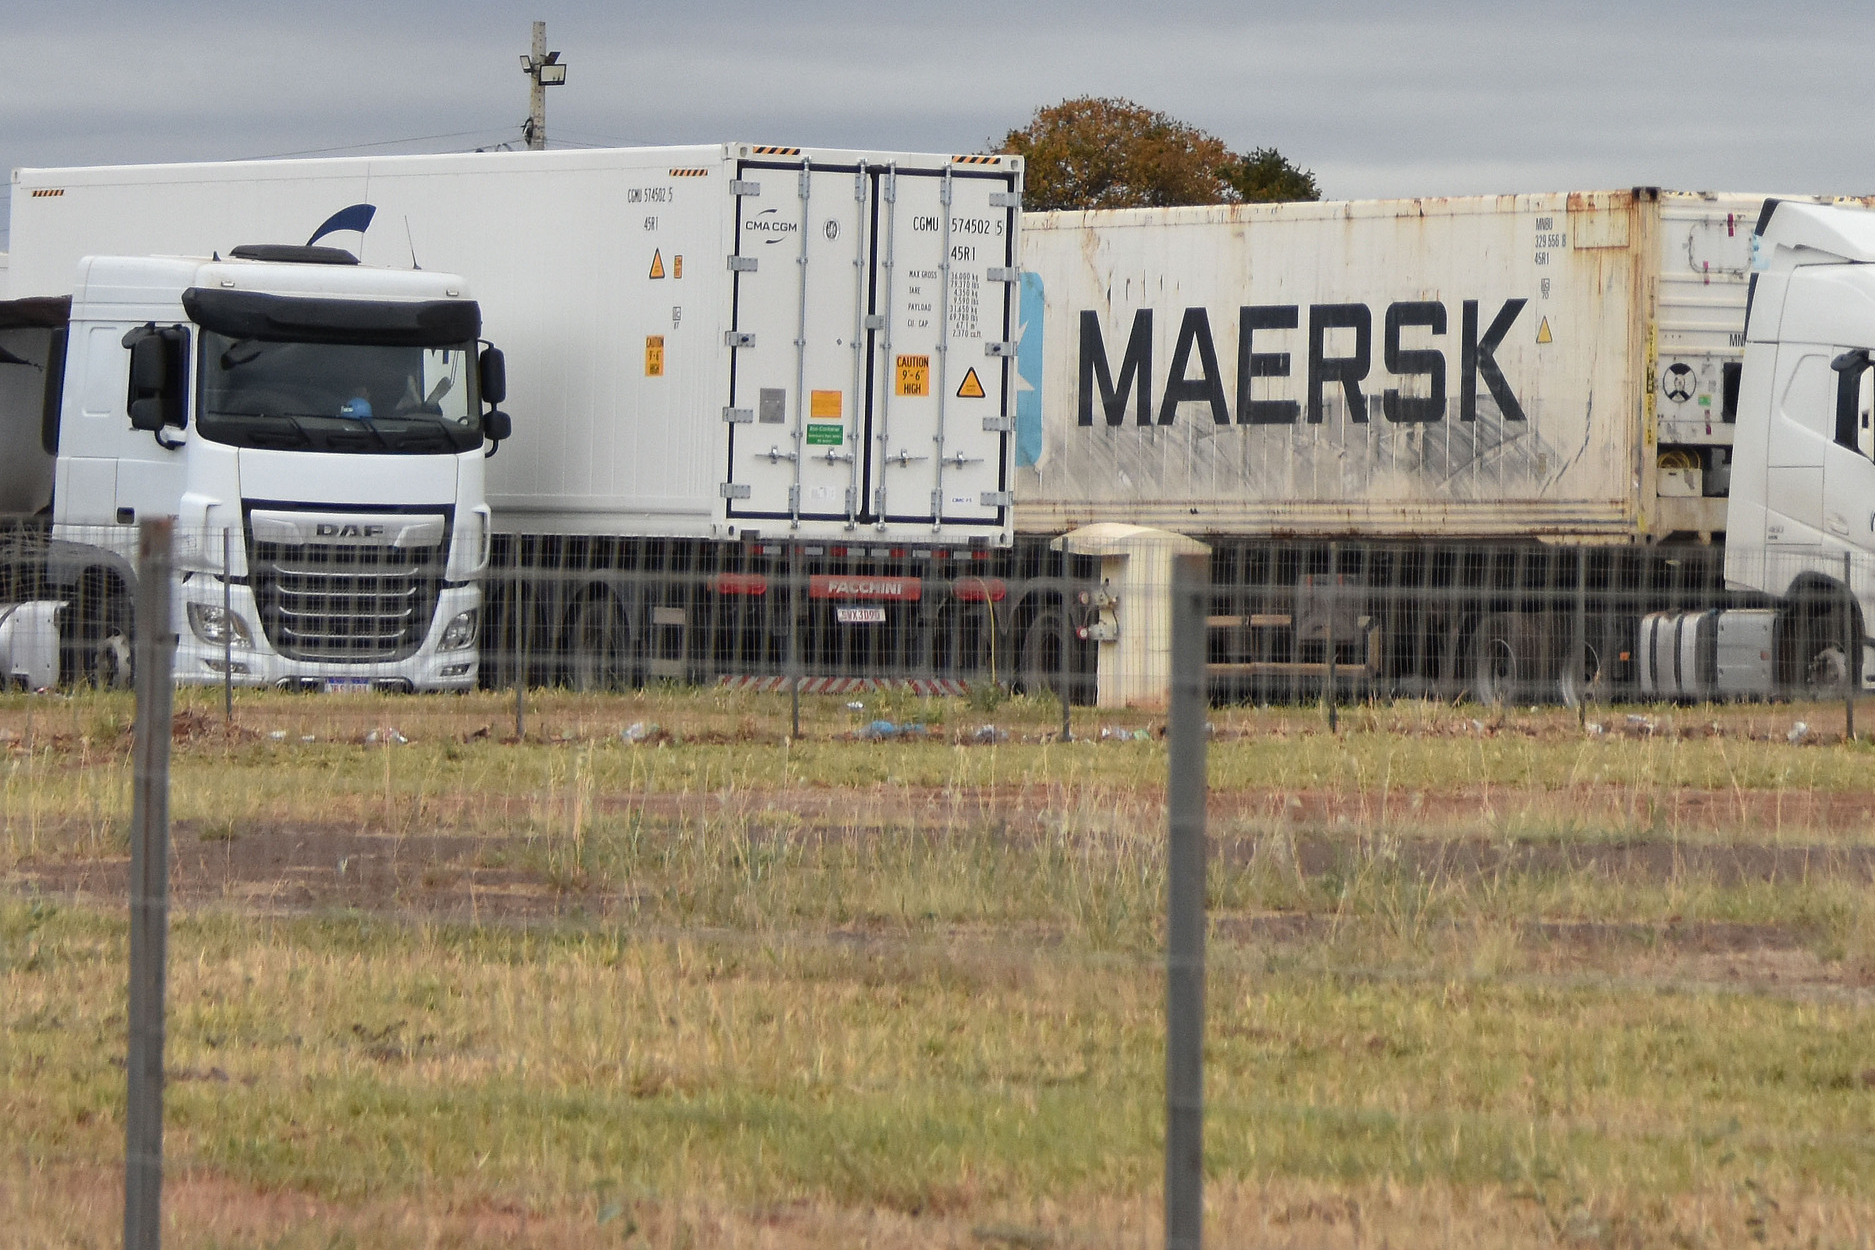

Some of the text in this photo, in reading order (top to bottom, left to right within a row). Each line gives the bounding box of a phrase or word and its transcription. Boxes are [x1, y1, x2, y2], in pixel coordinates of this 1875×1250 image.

[644, 188, 666, 203] 574502
[668, 187, 673, 202] 5
[745, 221, 797, 232] CMA CGM
[913, 216, 1003, 236] CGMU 574502 5
[1535, 234, 1547, 248] 329
[951, 246, 976, 261] 45R1
[907, 302, 932, 311] PAYLOAD
[897, 356, 929, 368] CAUTION
[1078, 298, 1528, 426] MAERSK
[903, 383, 921, 395] HIGH
[316, 524, 384, 537] DAF
[828, 580, 902, 595] FACCHINI
